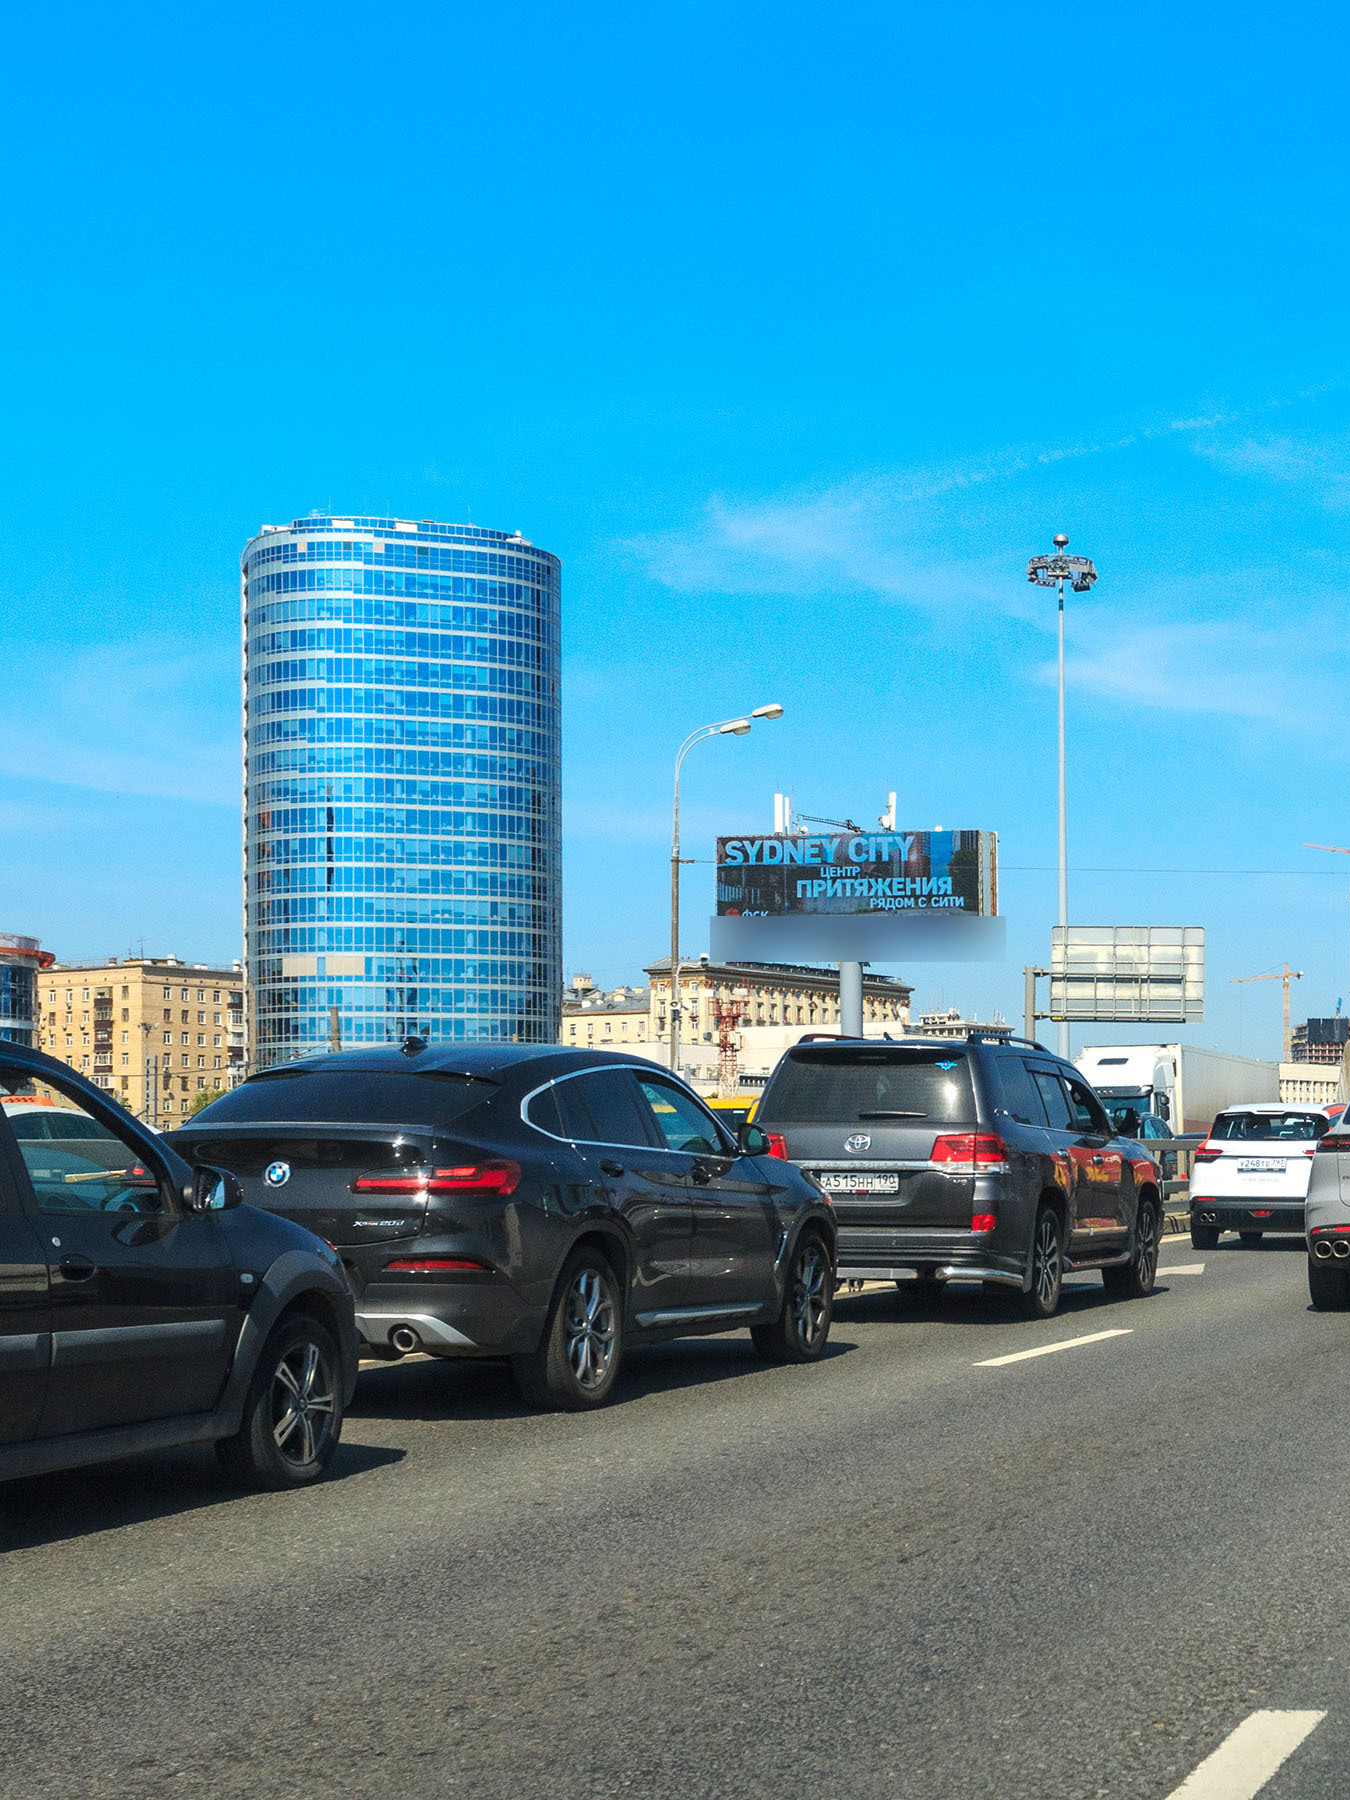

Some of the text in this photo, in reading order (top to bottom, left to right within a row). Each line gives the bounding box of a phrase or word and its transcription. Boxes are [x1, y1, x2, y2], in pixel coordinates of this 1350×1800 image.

[725, 836, 915, 865] SYDNEY CITY
[820, 866, 861, 878] ЦЕНТР
[796, 876, 952, 898] ПРИТЯЖЕНИЯ
[869, 896, 964, 910] РЯДОМ С СИТИ
[825, 1174, 895, 1188] А515НН 190
